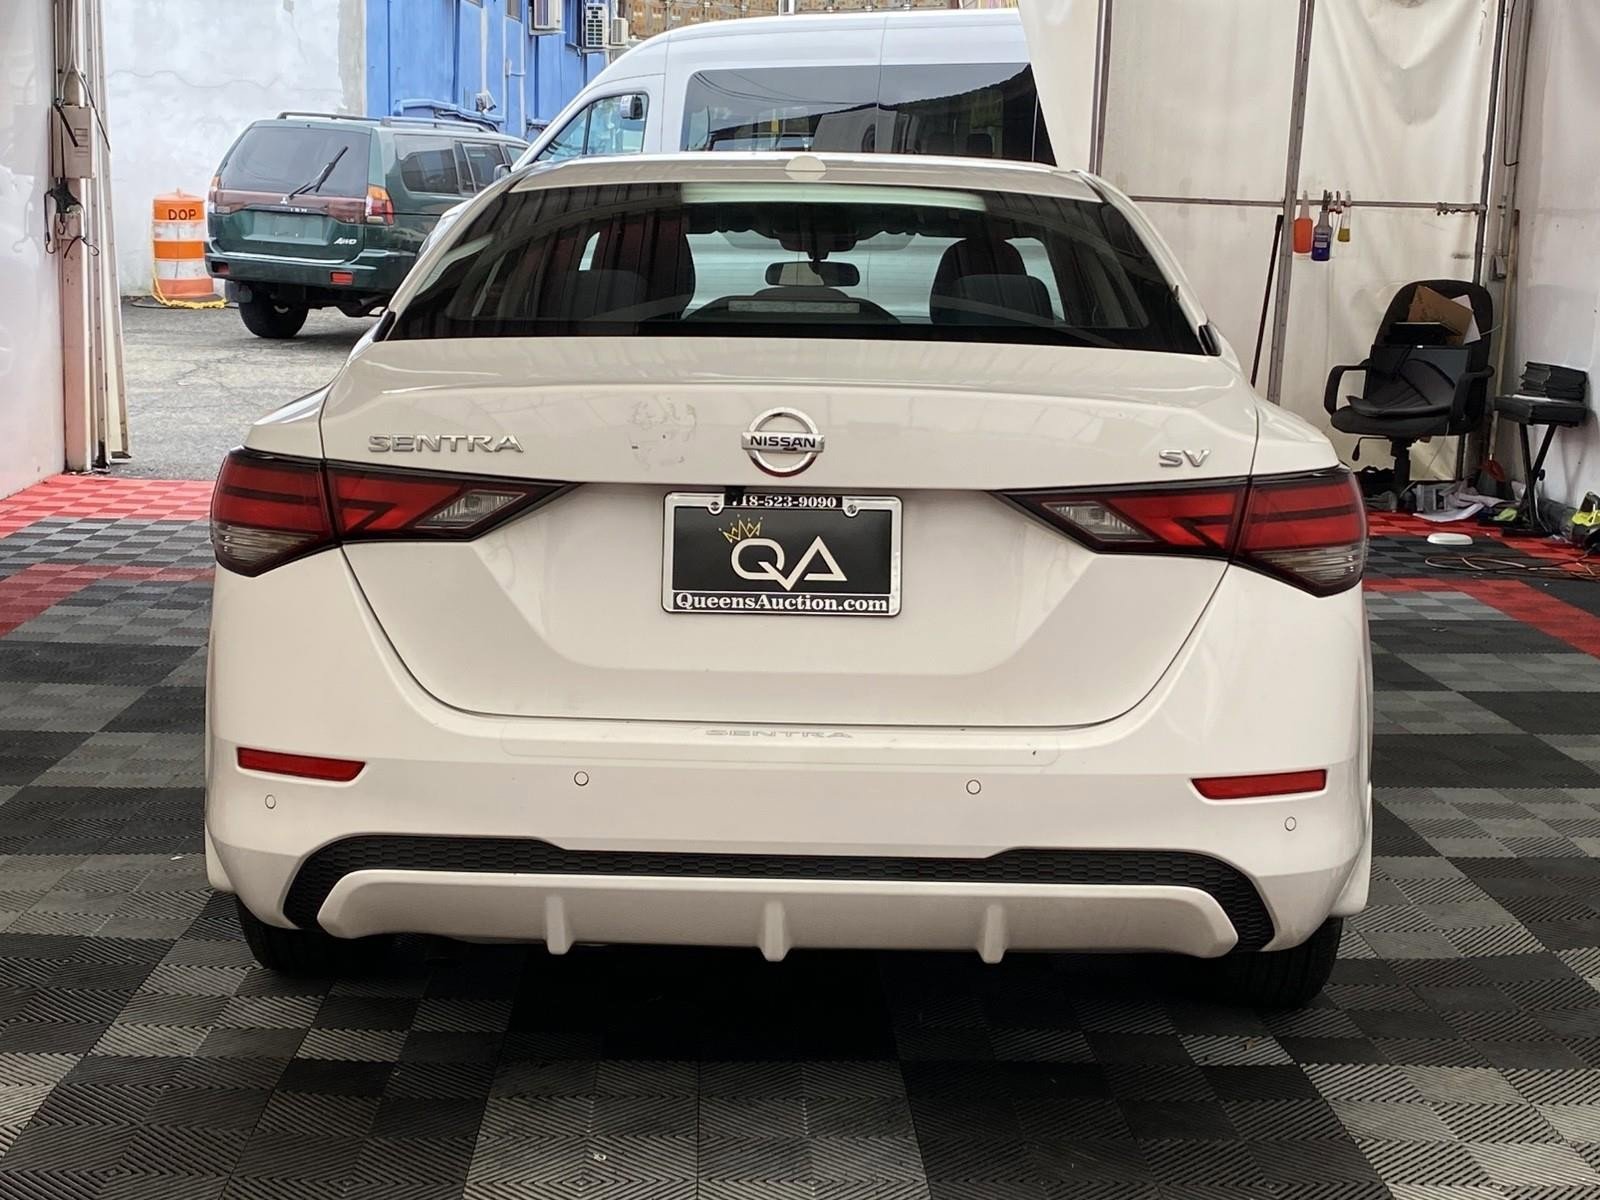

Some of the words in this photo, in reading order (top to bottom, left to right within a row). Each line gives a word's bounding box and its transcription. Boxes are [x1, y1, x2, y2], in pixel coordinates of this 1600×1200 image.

[168, 208, 197, 221] DOP
[368, 434, 524, 453] SENTRA
[750, 435, 816, 448] NISSAN
[1159, 449, 1210, 467] SV
[731, 537, 848, 591] QA
[675, 591, 888, 612] QueensAuction.com
[705, 729, 853, 739] SENTRA
